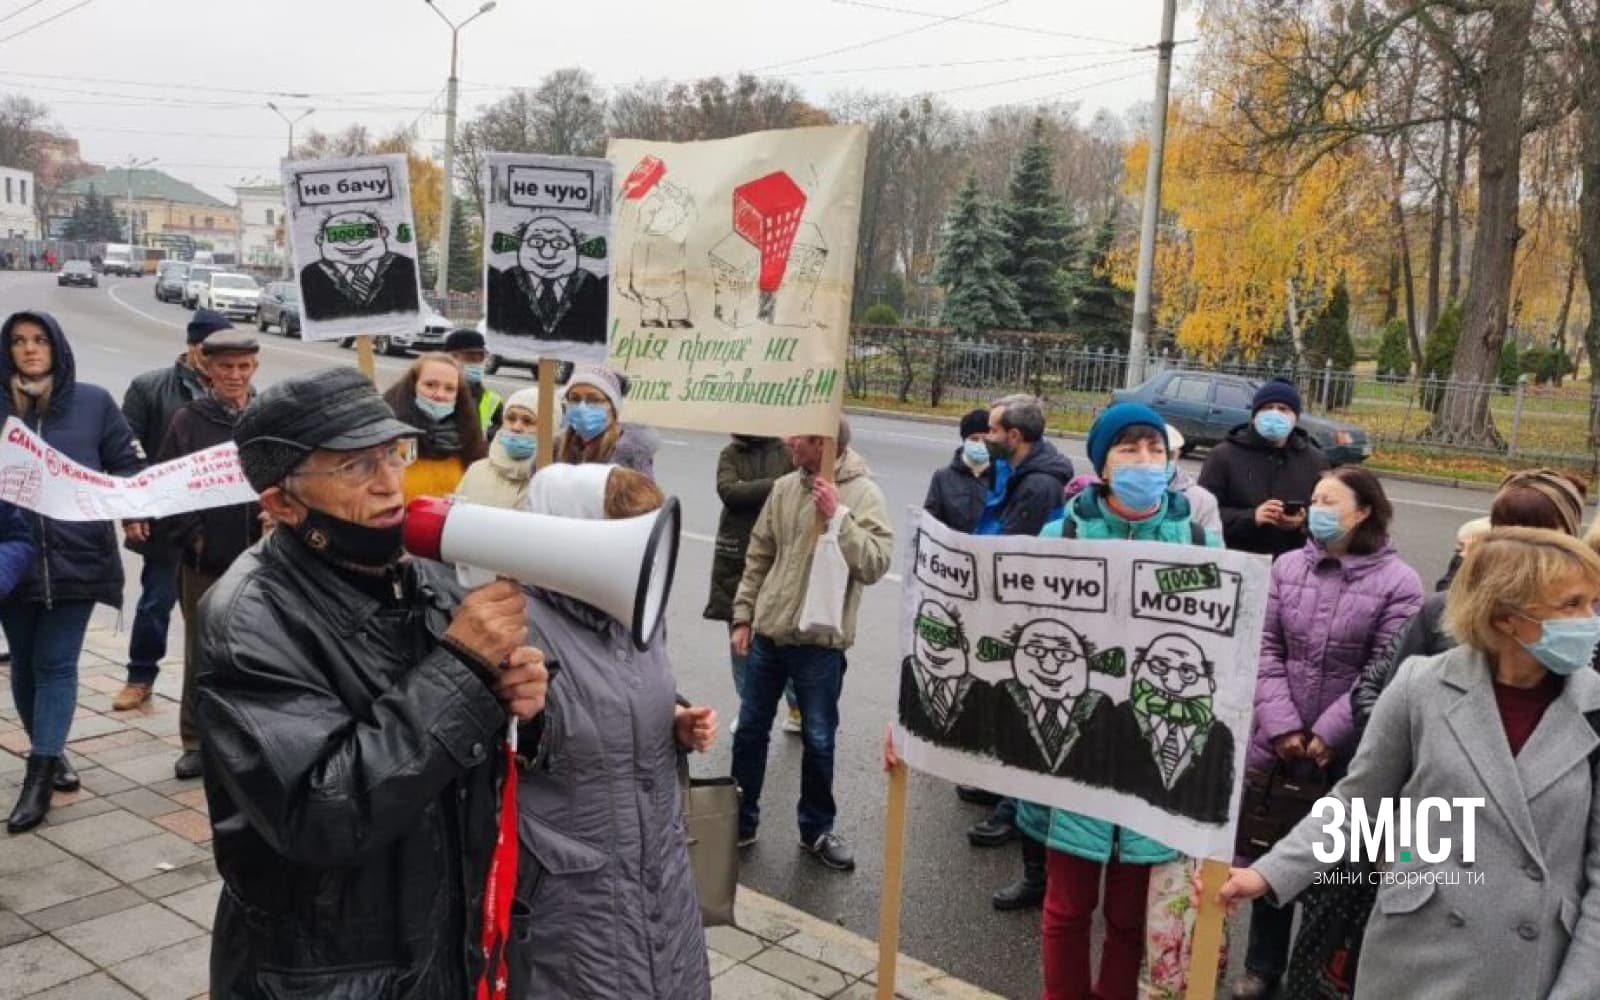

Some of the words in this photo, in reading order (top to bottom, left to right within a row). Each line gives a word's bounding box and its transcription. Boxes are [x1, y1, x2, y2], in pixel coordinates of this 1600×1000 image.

[304, 183, 331, 196] не
[336, 179, 387, 193] бачу
[513, 181, 539, 196] не
[544, 183, 588, 203] чую
[763, 335, 799, 362] на
[930, 554, 971, 589] бачу
[1002, 573, 1035, 591] не
[1043, 575, 1101, 600] чую
[1141, 591, 1231, 627] мовчу
